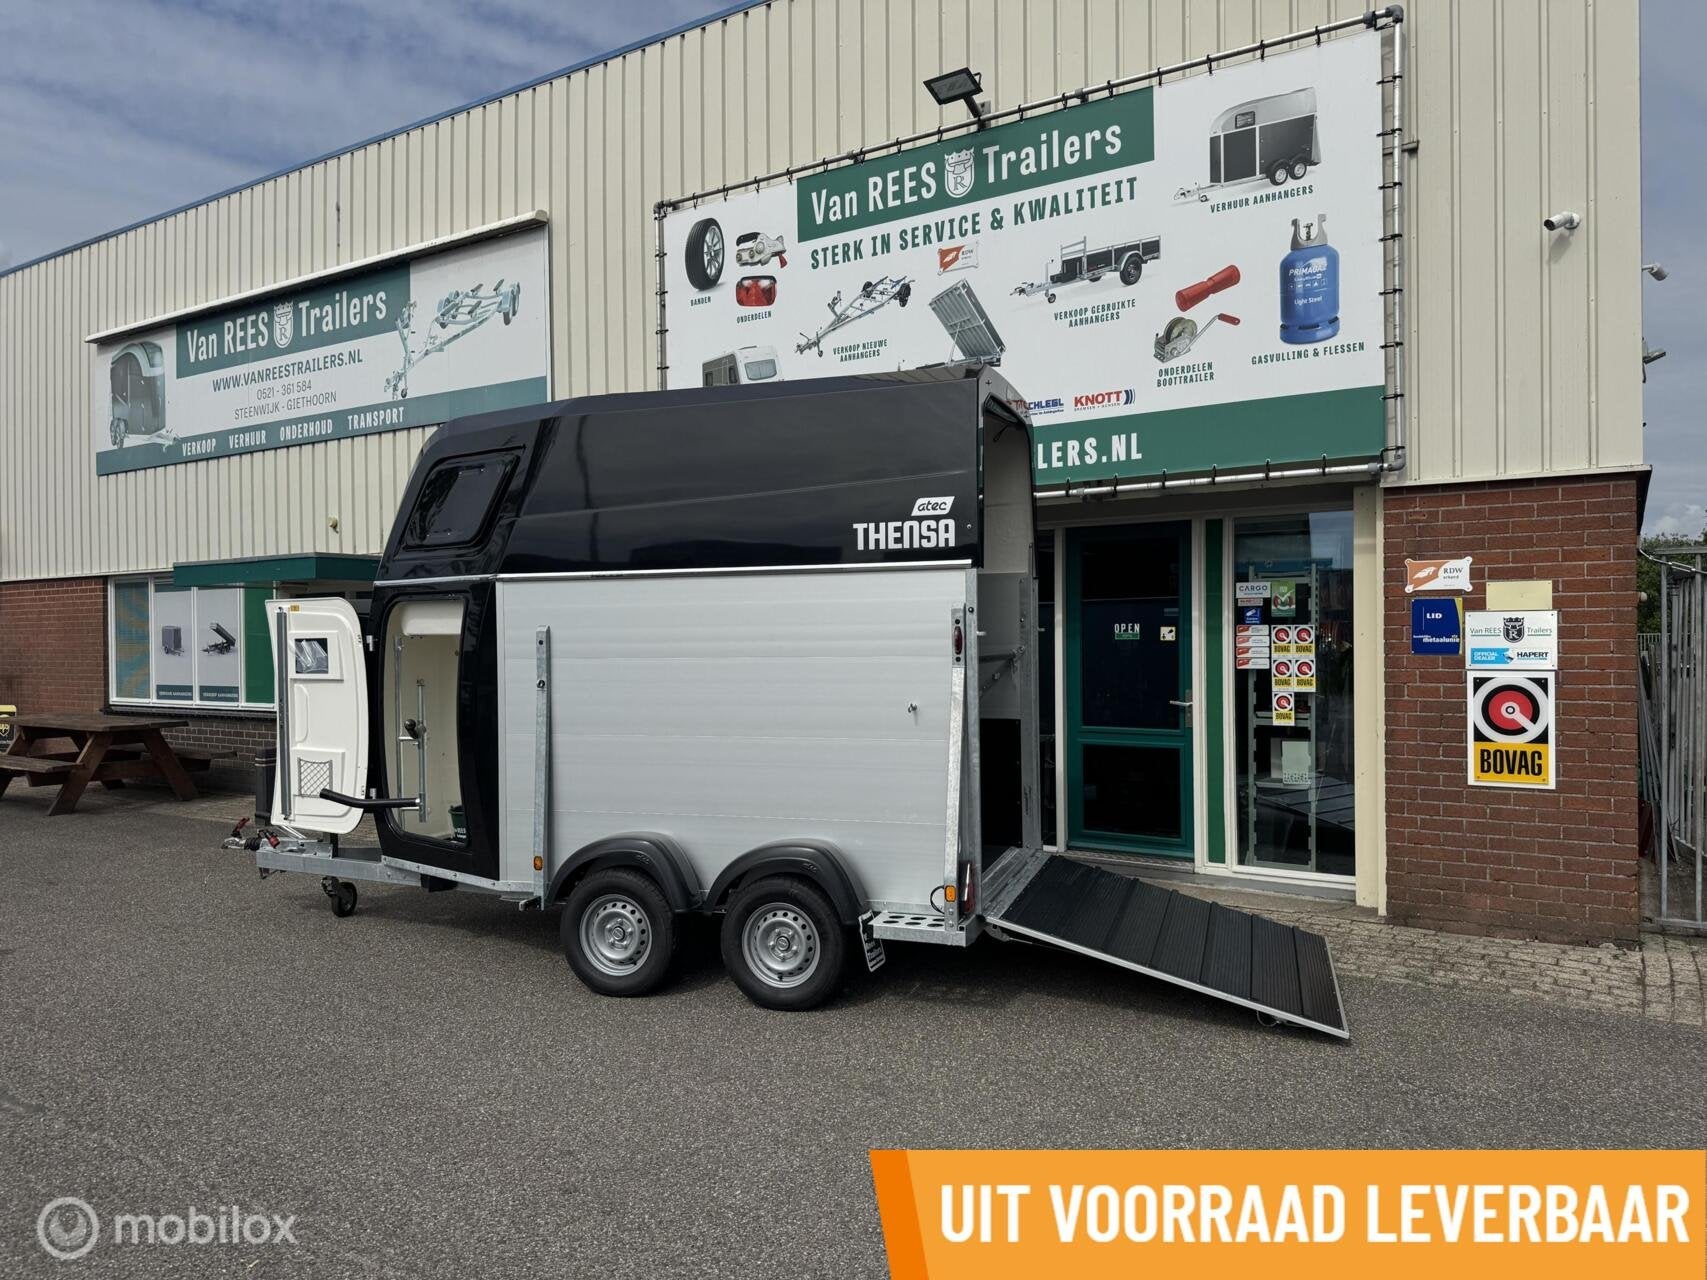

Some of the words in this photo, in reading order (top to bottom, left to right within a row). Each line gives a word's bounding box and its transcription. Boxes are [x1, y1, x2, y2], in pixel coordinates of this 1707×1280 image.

[811, 188, 858, 225] Van
[868, 161, 937, 213] REES
[983, 124, 1122, 184] Trailers
[1210, 197, 1250, 213] VERHUUR
[1253, 185, 1313, 205] AANHANGERS
[811, 239, 864, 270] STERK
[871, 233, 891, 256] IN
[899, 212, 981, 251] SERVICE
[990, 208, 1004, 230] &
[1014, 177, 1138, 226] KWALITEIT
[736, 310, 772, 324] ONDERDELEN
[1054, 307, 1088, 321] VERKOOP
[1091, 298, 1136, 315] GEBRUIKTE
[187, 328, 217, 363] Van
[224, 311, 269, 355] REES
[299, 291, 387, 337] Trailers
[1068, 311, 1120, 328] AANHANGERS
[833, 343, 860, 355] VERKOOP
[862, 339, 888, 350] NIEUWE
[840, 349, 880, 362] AANHANGERS
[1251, 349, 1309, 365] GASVULLING
[1312, 348, 1320, 357] &
[1323, 342, 1365, 356] FLESSEN
[212, 349, 363, 393] WWW.VANREESTRAILERS.NL
[1158, 361, 1213, 378] ONDERDELEN
[1157, 372, 1215, 388] BOOTTRAILER
[256, 387, 274, 400] 0521
[1074, 390, 1122, 408] KNOTT
[234, 401, 280, 420] STEENWIJK
[287, 391, 337, 411] GIETHOORN
[182, 438, 217, 457] VERKOOP
[229, 430, 267, 449] VERHUUR
[279, 419, 333, 442] ONDERHOUD
[347, 407, 405, 431] TRANSPORT
[1037, 432, 1143, 469] LERS.NL
[917, 500, 947, 512] atec
[852, 518, 956, 550] THENSA
[1443, 567, 1463, 575] RDW
[1114, 623, 1140, 633] OPEN
[1526, 626, 1552, 634] Trailers
[1274, 645, 1291, 653] BOVAG
[1295, 645, 1312, 653] BOVAG
[1274, 678, 1291, 686] BOVAG
[1296, 678, 1314, 686] BOVAG
[1275, 712, 1292, 720] BOVAG
[1480, 748, 1543, 776] BOVAG
